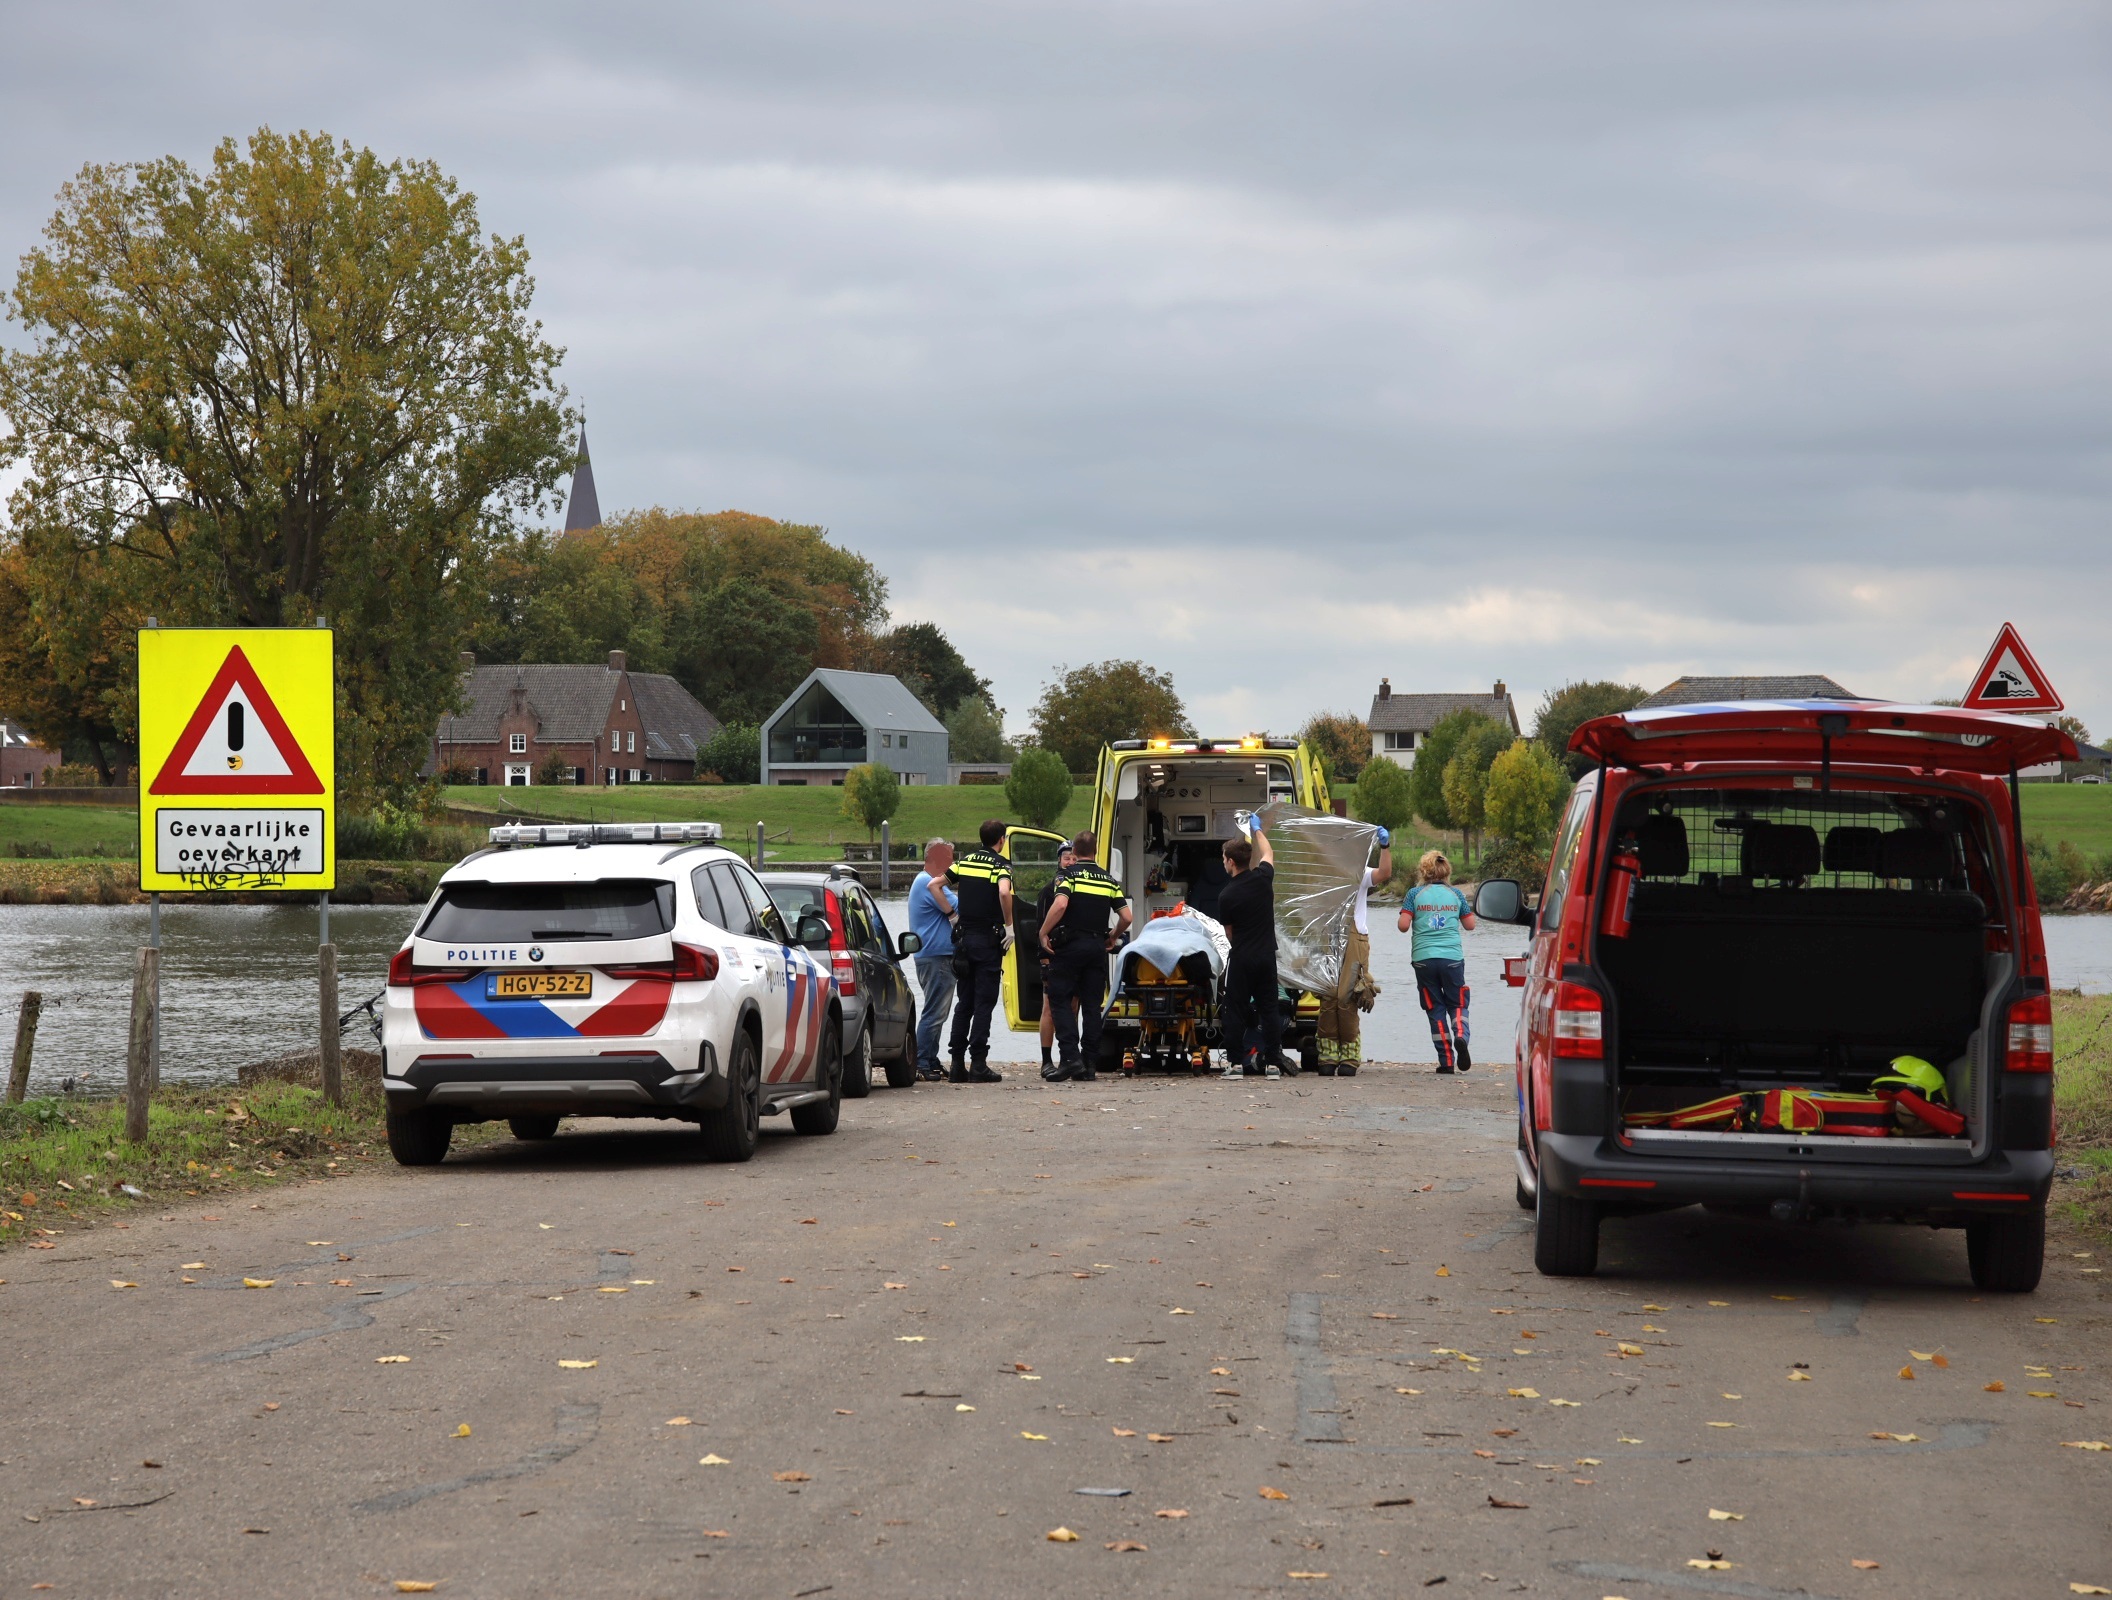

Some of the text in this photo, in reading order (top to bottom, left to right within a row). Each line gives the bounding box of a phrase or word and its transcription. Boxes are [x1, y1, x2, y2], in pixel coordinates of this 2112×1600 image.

[169, 820, 310, 842] Gevaarlijke
[178, 845, 302, 863] oeverkant
[1416, 904, 1458, 912] AMBULANCE
[447, 950, 517, 961] POLITIE
[503, 976, 585, 993] HGV-52-Z
